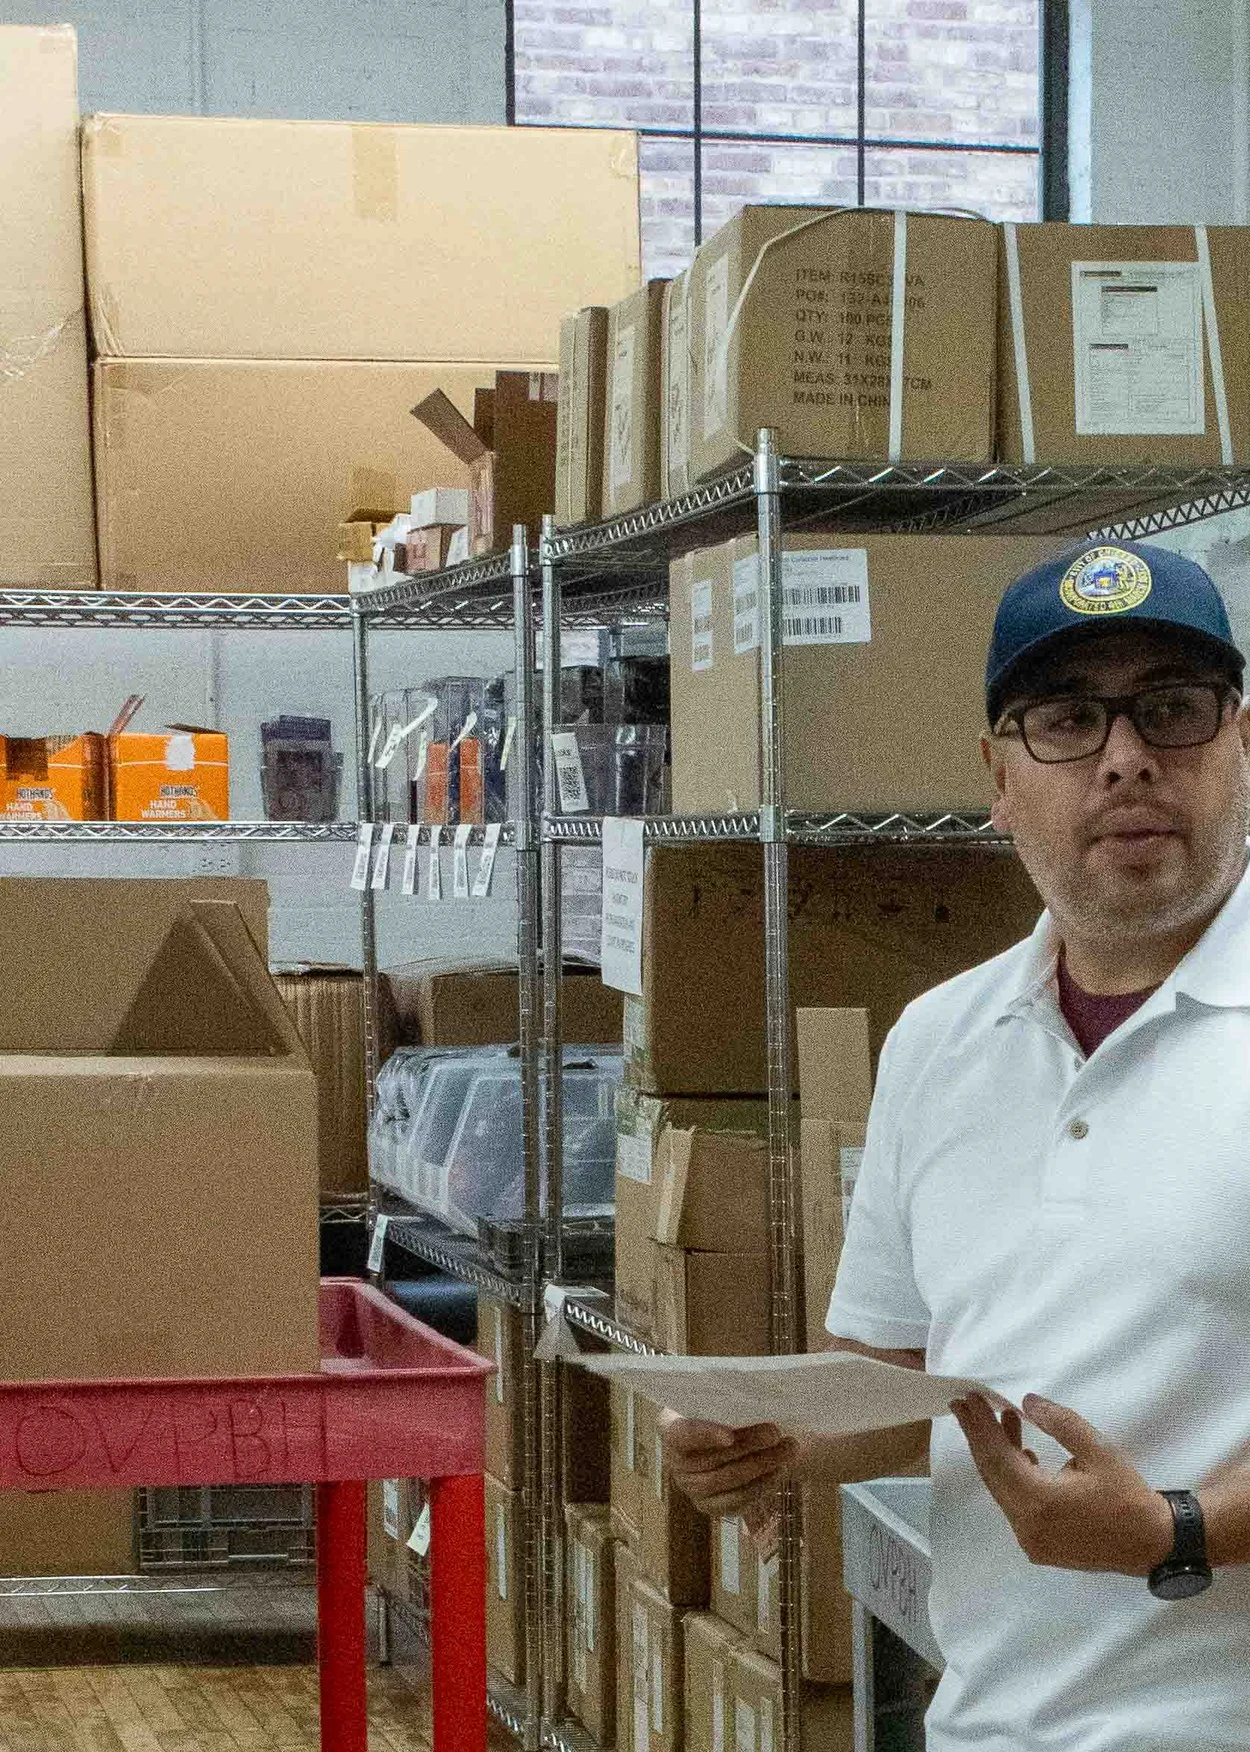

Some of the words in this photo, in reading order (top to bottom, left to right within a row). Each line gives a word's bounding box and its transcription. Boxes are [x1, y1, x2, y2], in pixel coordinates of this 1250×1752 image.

[793, 391, 835, 406] MADE
[839, 392, 853, 406] IN
[857, 393, 891, 408] CHIN
[6, 801, 33, 812] HAND
[150, 800, 177, 809] HAND
[141, 809, 186, 819] WARMERS
